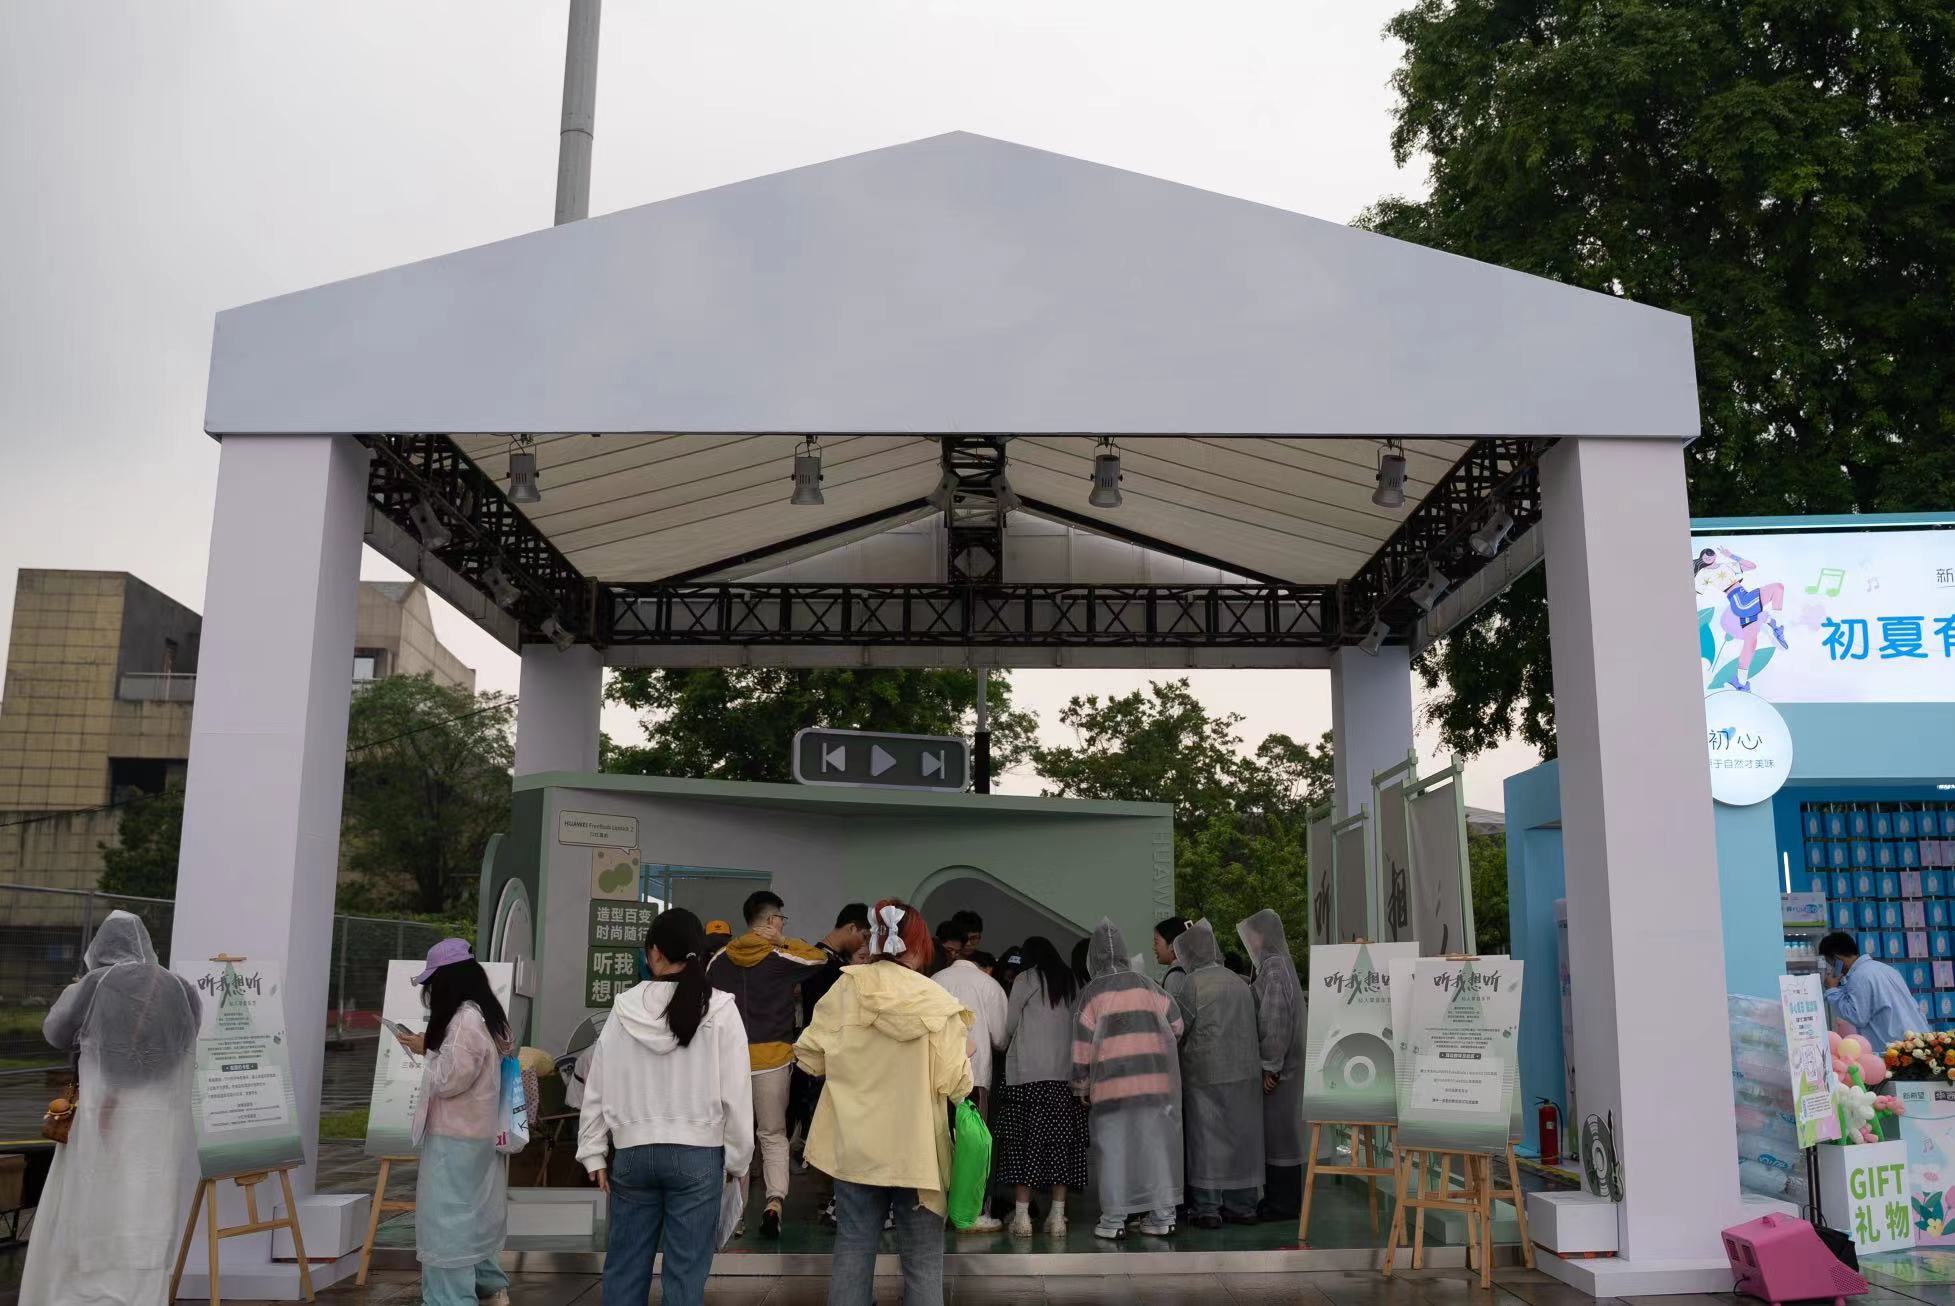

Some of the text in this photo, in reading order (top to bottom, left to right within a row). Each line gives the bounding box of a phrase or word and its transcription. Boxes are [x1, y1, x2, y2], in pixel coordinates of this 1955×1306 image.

[1709, 728, 1763, 751] 初心
[1151, 832, 1170, 922] HUAWE
[597, 907, 653, 924] 造型百变
[596, 925, 650, 941] 时尚随行
[594, 952, 634, 975] 听我
[197, 972, 263, 1008] 听我想听
[1433, 970, 1502, 1002] 听我想听
[1849, 1163, 1904, 1200] GIFT
[1855, 1200, 1910, 1245] 礼物
